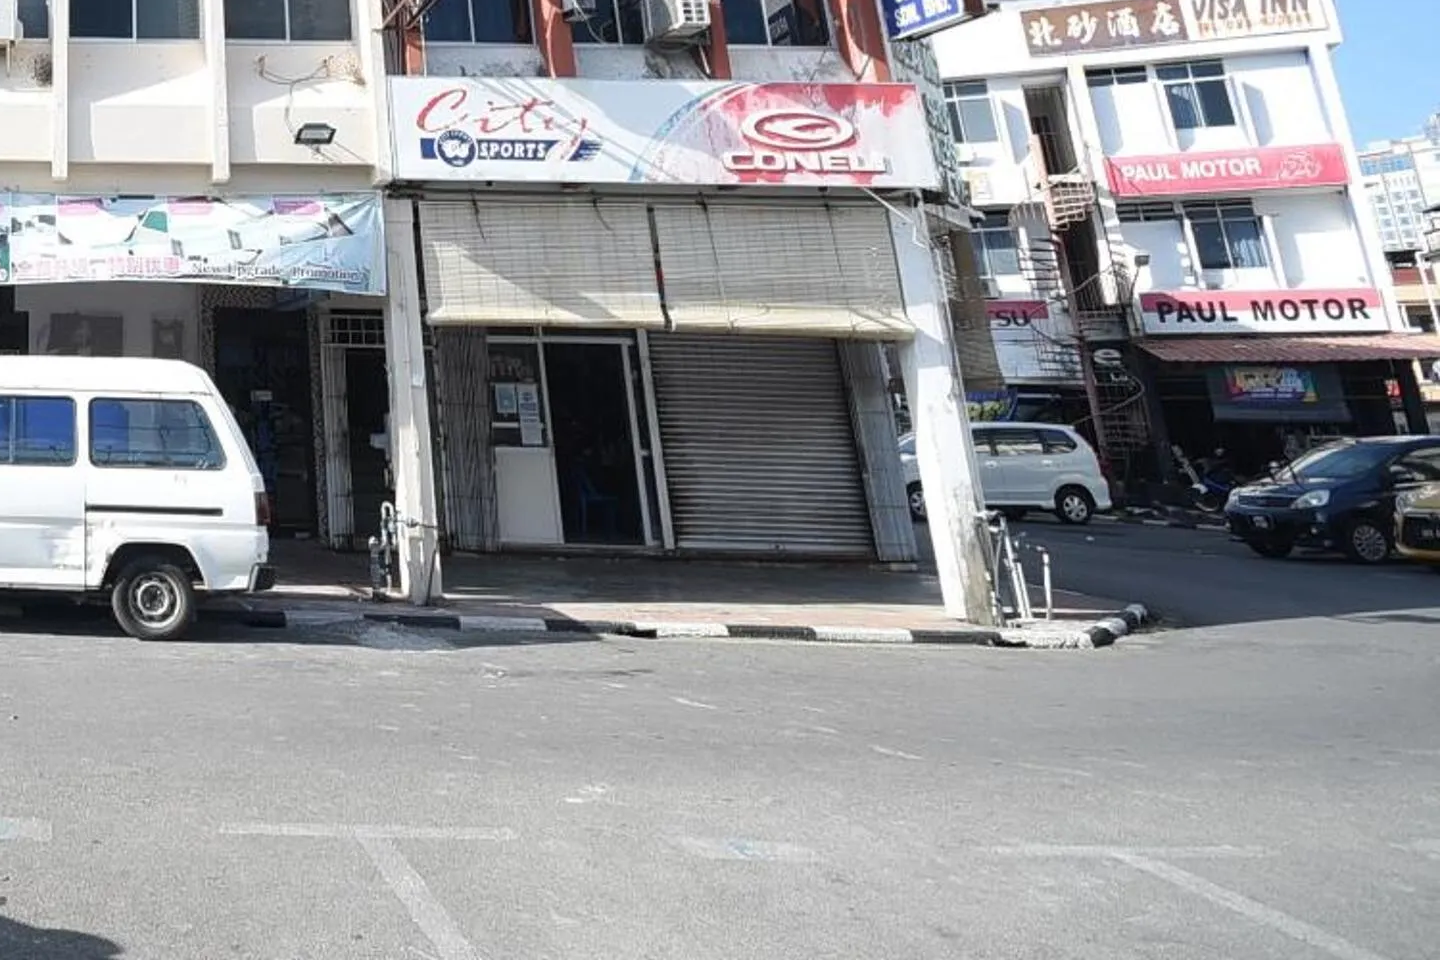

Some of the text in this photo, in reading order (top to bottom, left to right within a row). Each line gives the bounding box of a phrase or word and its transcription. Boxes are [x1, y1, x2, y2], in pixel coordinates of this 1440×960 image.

[479, 141, 547, 159] SPORTS
[1121, 157, 1262, 182] PAUL MOTOR
[290, 266, 362, 281] Promotion
[1157, 296, 1371, 324] PAUL MOTOR
